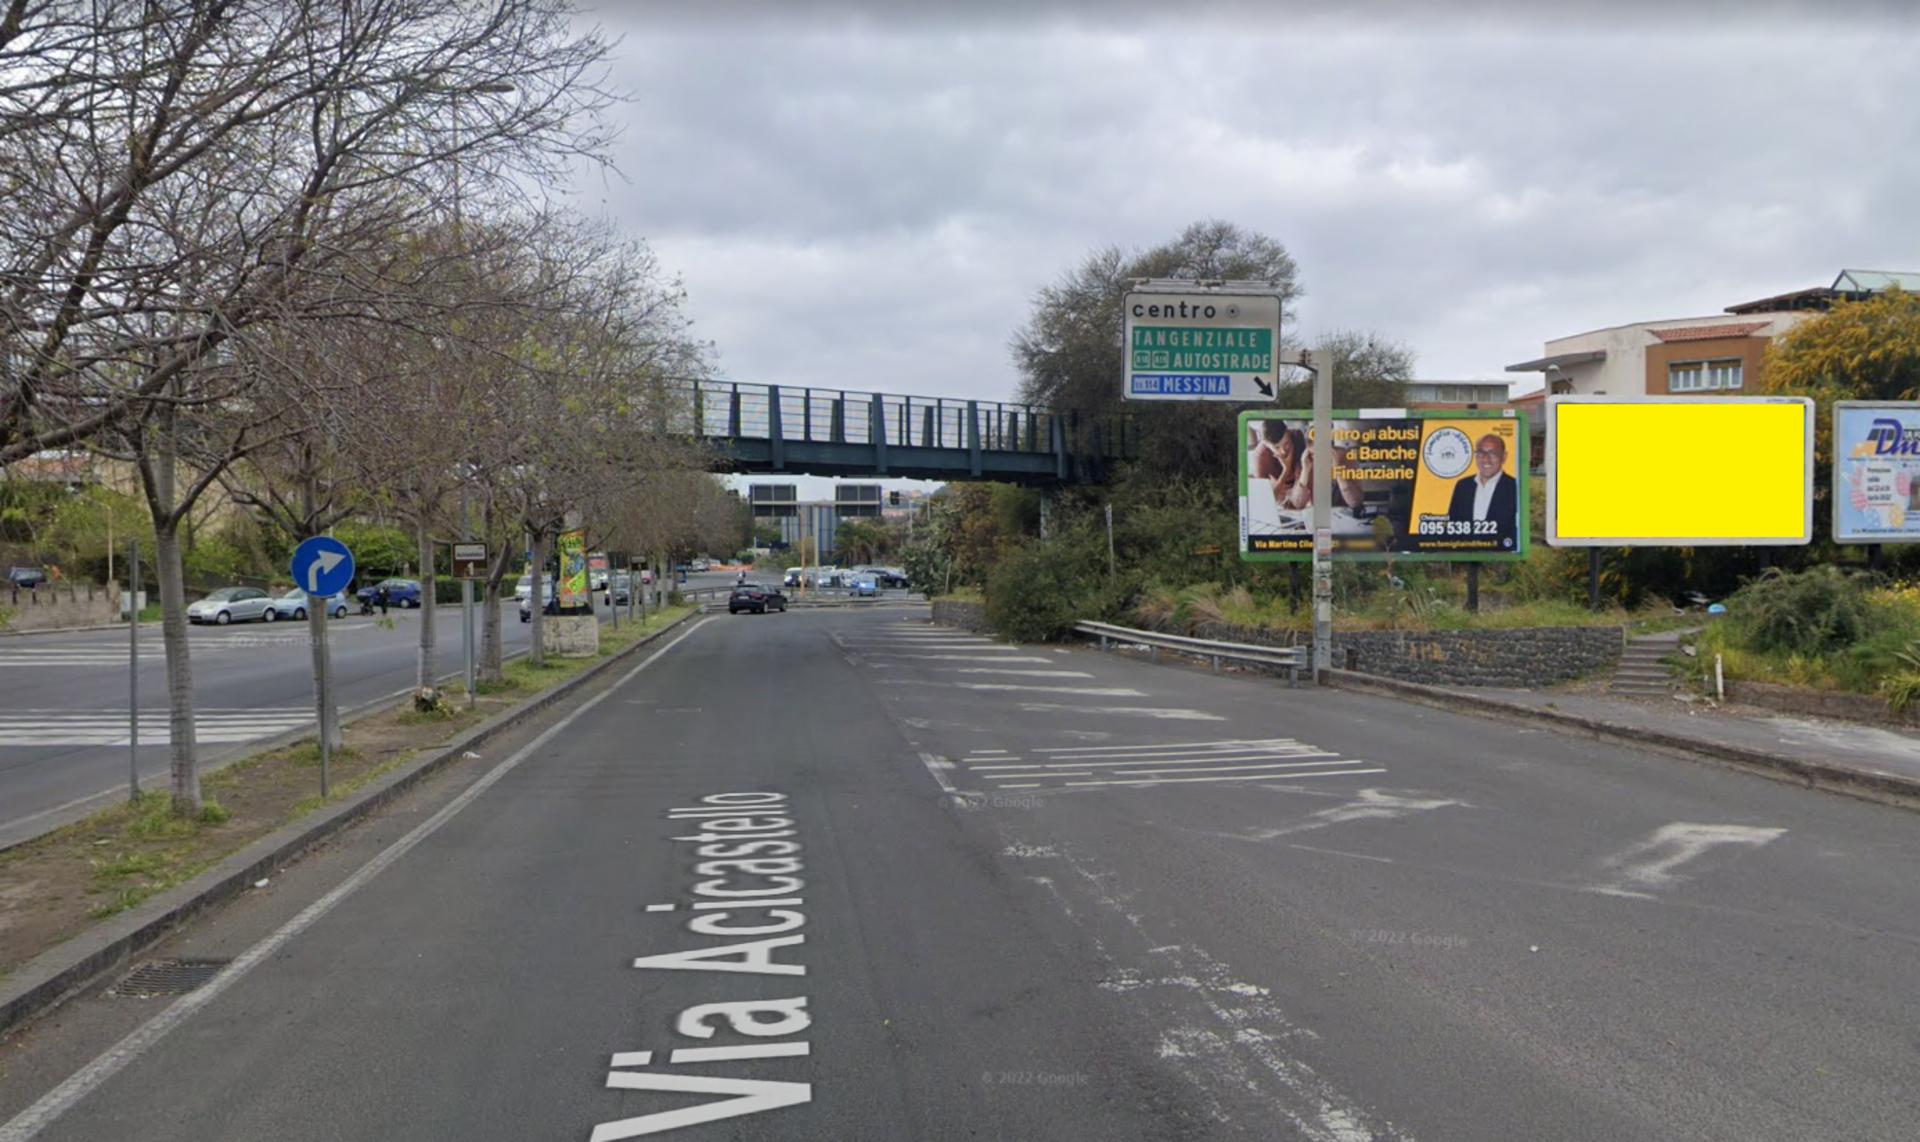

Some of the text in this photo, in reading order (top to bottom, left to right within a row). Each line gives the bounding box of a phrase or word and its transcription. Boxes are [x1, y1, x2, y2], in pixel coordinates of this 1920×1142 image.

[1132, 301, 1216, 318] centro
[1134, 330, 1257, 347] TANGENZIALE
[1173, 352, 1270, 369] AUTOSTRADE
[1163, 377, 1227, 393] MESSINA
[1362, 429, 1376, 443] gli
[1378, 425, 1419, 441] abusi
[1346, 444, 1417, 460] di Banche
[1332, 465, 1414, 480] Finanziarie
[1420, 521, 1498, 535] 095 538 222
[1255, 541, 1267, 549] Via
